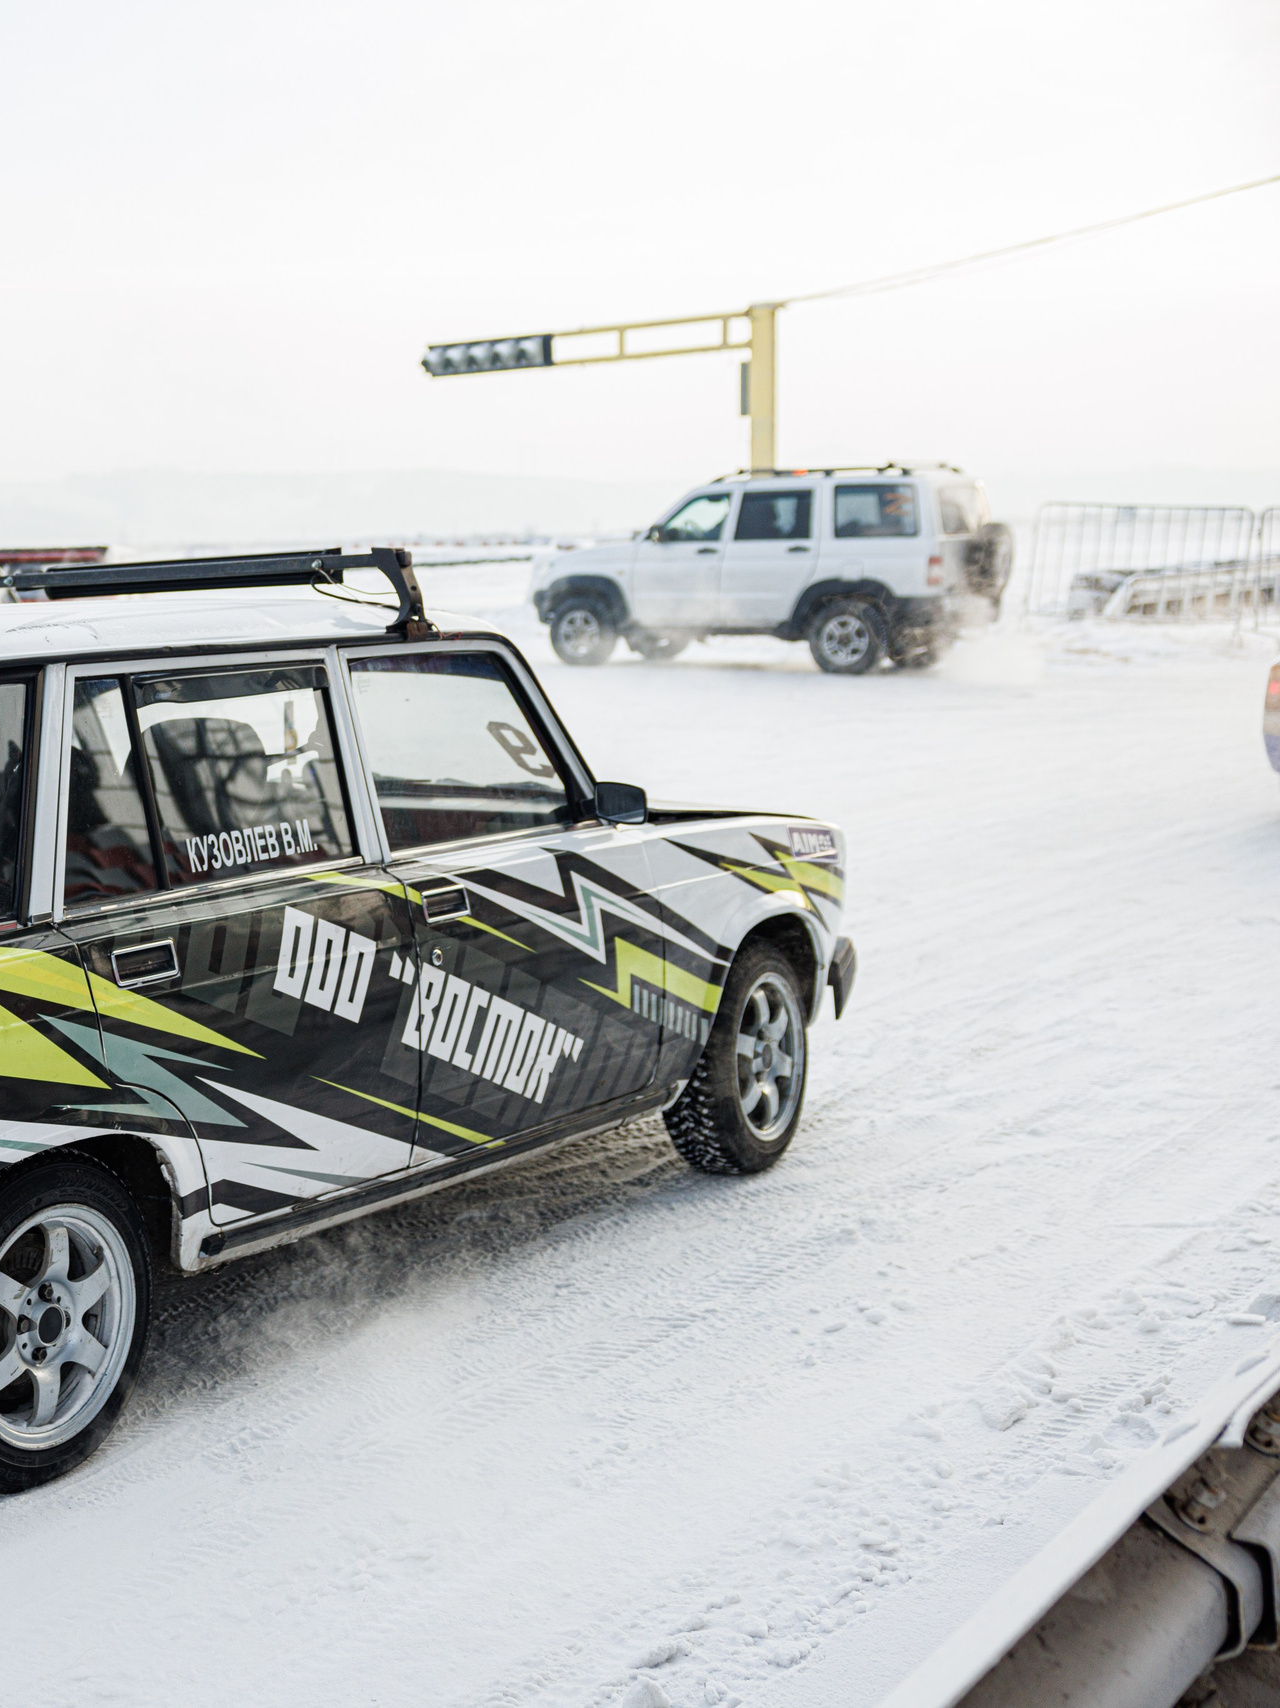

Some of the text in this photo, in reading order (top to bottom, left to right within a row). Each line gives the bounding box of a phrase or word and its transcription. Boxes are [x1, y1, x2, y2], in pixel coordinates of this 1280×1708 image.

[185, 819, 319, 873] КУЗОВЛЕВ В.М.
[273, 905, 377, 1024] ООО
